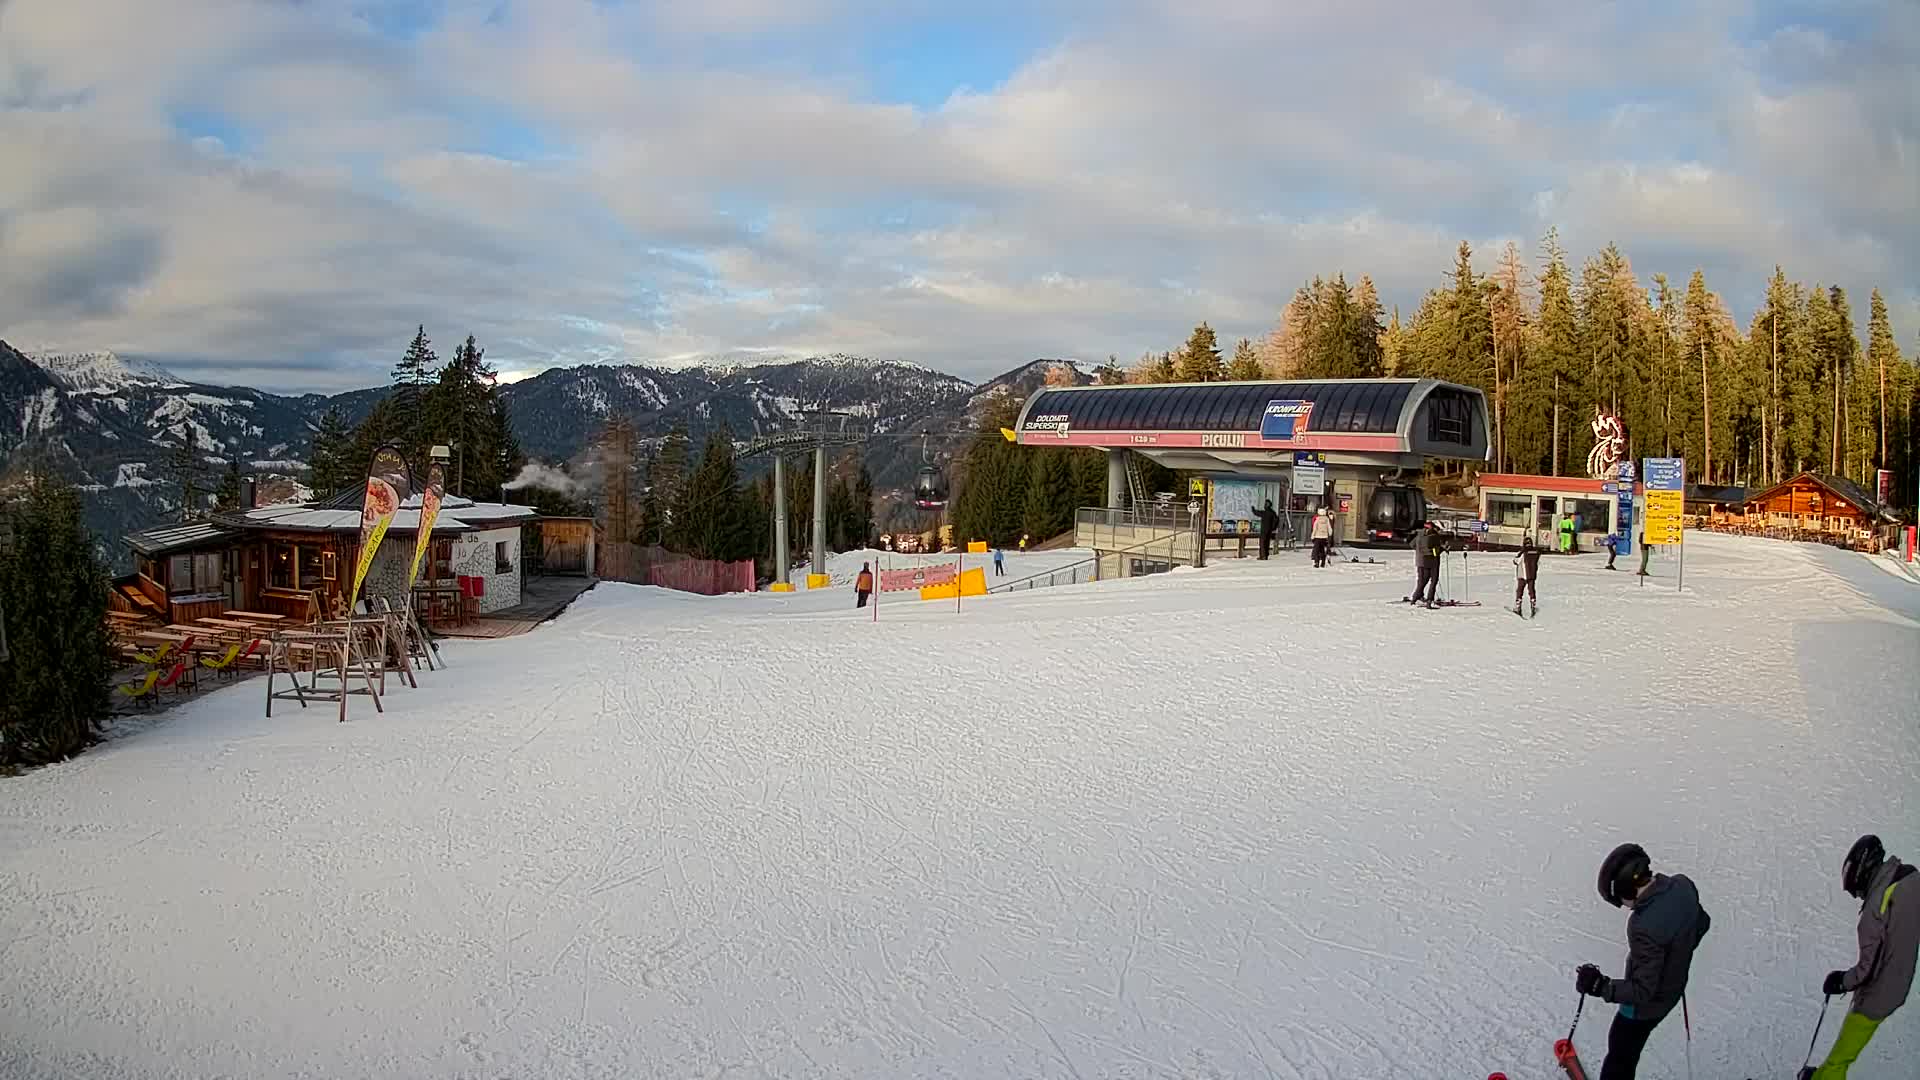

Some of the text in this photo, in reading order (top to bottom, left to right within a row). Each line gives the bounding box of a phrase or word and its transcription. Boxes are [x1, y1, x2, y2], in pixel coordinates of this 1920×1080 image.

[1267, 405, 1312, 413] KRONPLATZ
[1025, 422, 1058, 430] SUPERSKI
[1201, 433, 1246, 448] PICULIN
